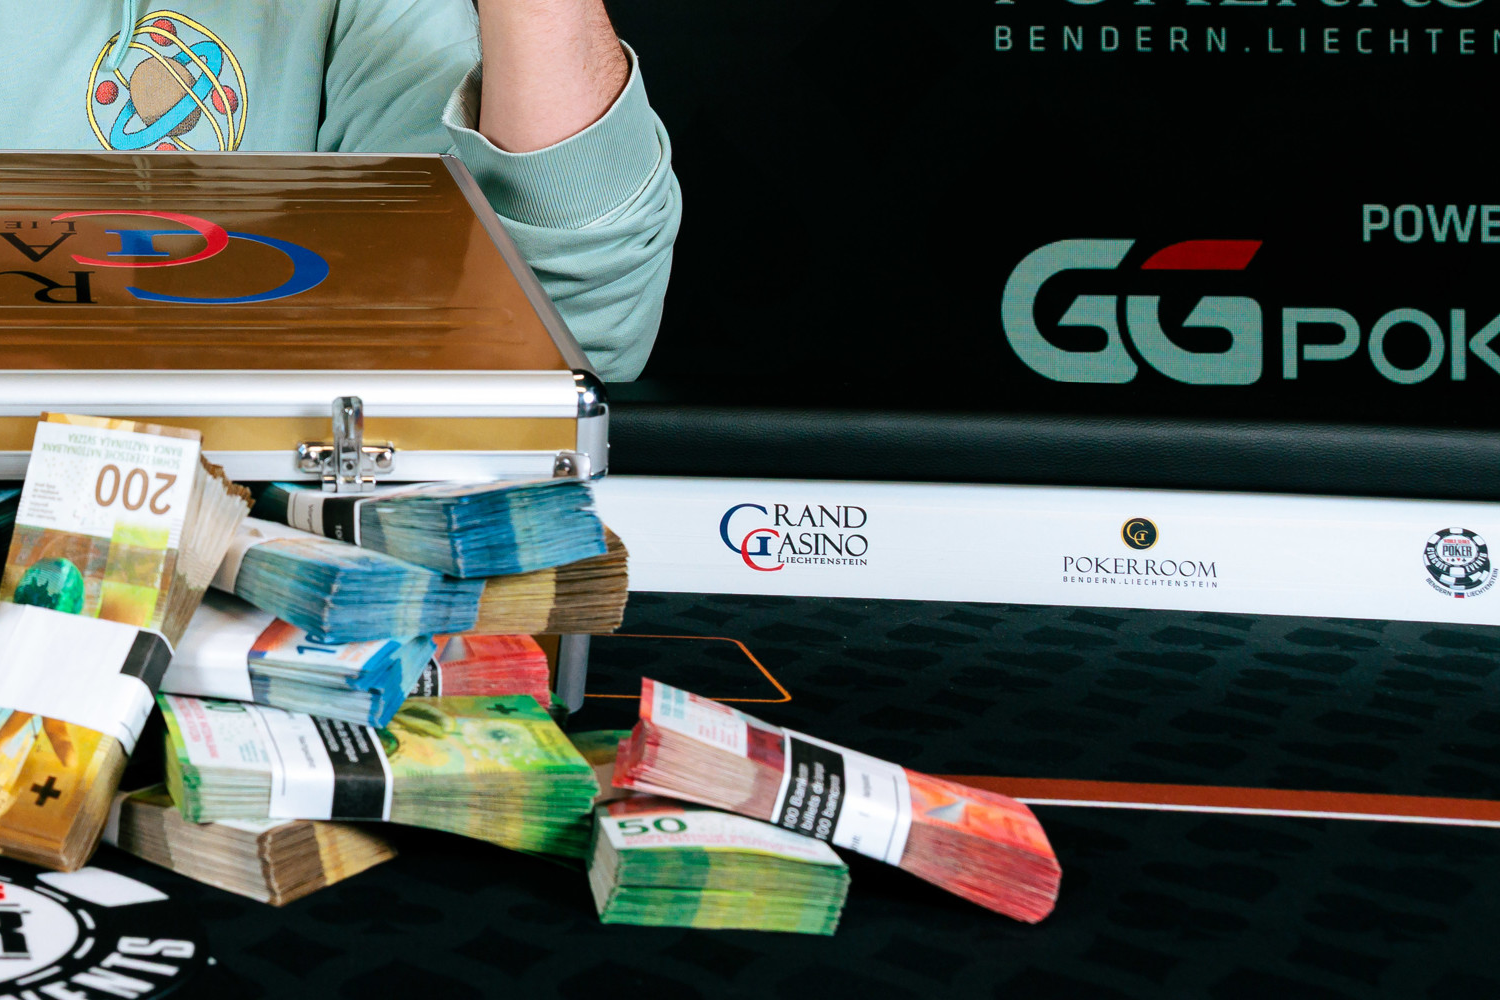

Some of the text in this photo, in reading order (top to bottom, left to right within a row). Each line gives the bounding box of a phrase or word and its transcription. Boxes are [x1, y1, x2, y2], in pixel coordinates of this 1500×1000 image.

[95, 464, 177, 515] 200
[1443, 545, 1472, 556] POKER
[777, 554, 868, 566] LIECHTENSTEIN
[617, 817, 688, 837] 50
